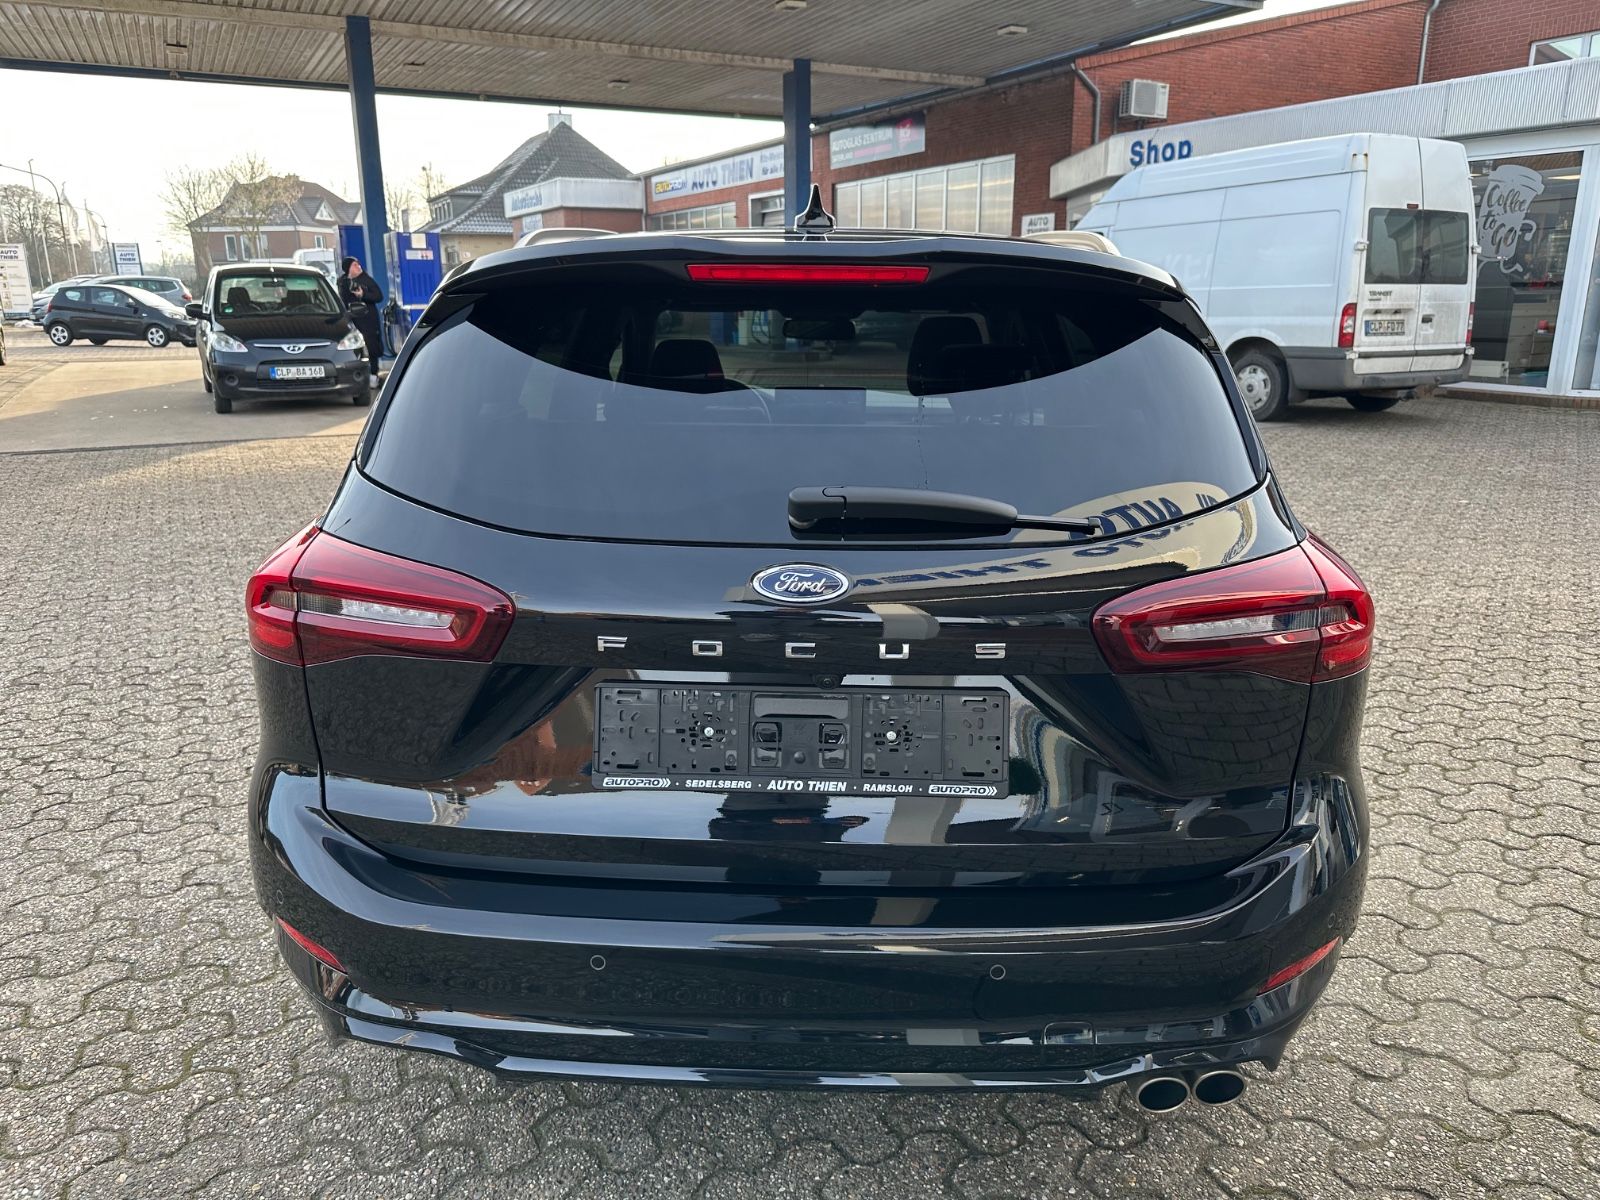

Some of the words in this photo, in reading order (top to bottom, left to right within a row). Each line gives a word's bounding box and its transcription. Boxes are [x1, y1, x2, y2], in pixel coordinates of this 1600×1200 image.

[1130, 139, 1193, 167] Shop
[691, 165, 718, 191] AUTO
[721, 157, 754, 185] THIEN
[1487, 184, 1526, 214] Coffee
[1027, 216, 1049, 227] AUTO
[1481, 210, 1497, 230] to
[276, 367, 292, 377] CLP
[296, 367, 307, 377] BA
[309, 367, 324, 376] 168
[774, 572, 826, 593] Ford
[597, 635, 1007, 660] FOCUS
[685, 779, 752, 789] SEDELSBERG
[767, 780, 804, 791] AUTO
[807, 781, 848, 792] THIEN
[863, 783, 913, 793] RAMSLOH
